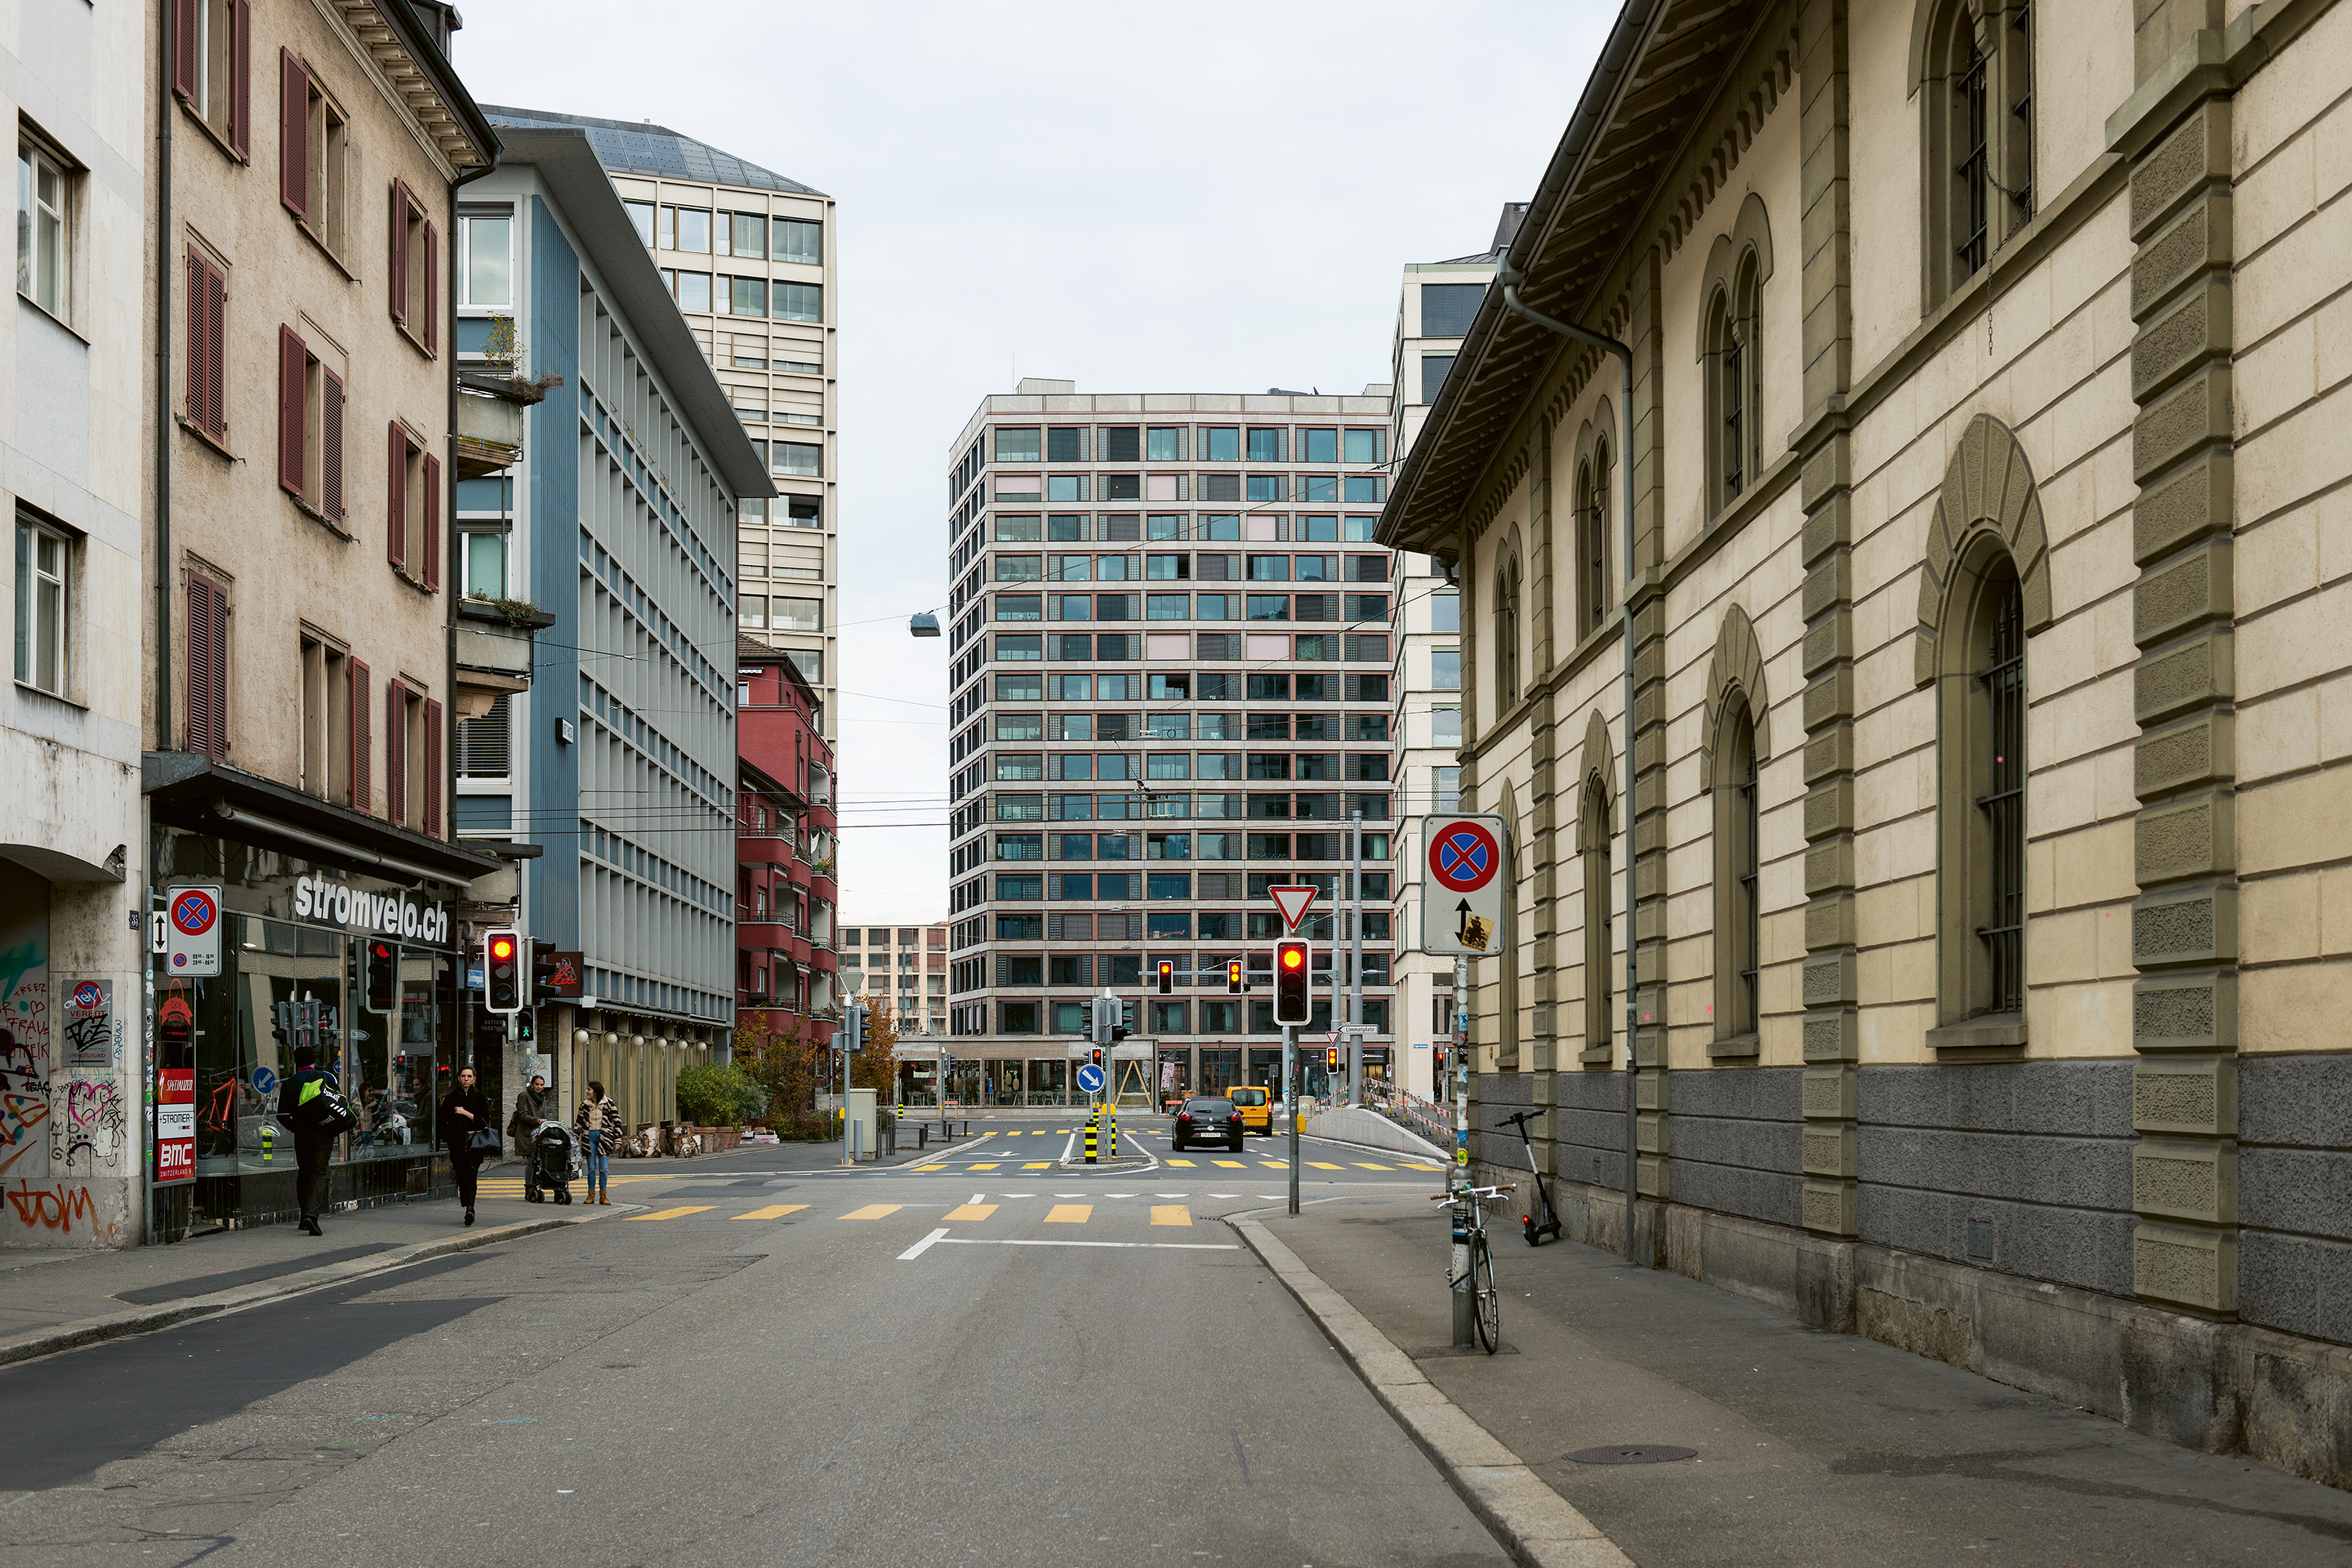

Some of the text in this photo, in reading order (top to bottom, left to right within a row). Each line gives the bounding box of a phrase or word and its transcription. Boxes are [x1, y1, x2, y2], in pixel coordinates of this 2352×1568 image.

[295, 869, 448, 943] stromvelo.ch
[131, 913, 139, 927] 35
[167, 1080, 193, 1091] SPECIALIZED
[160, 1143, 193, 1167] BMC
[160, 1169, 188, 1178] SWITZERLAND
